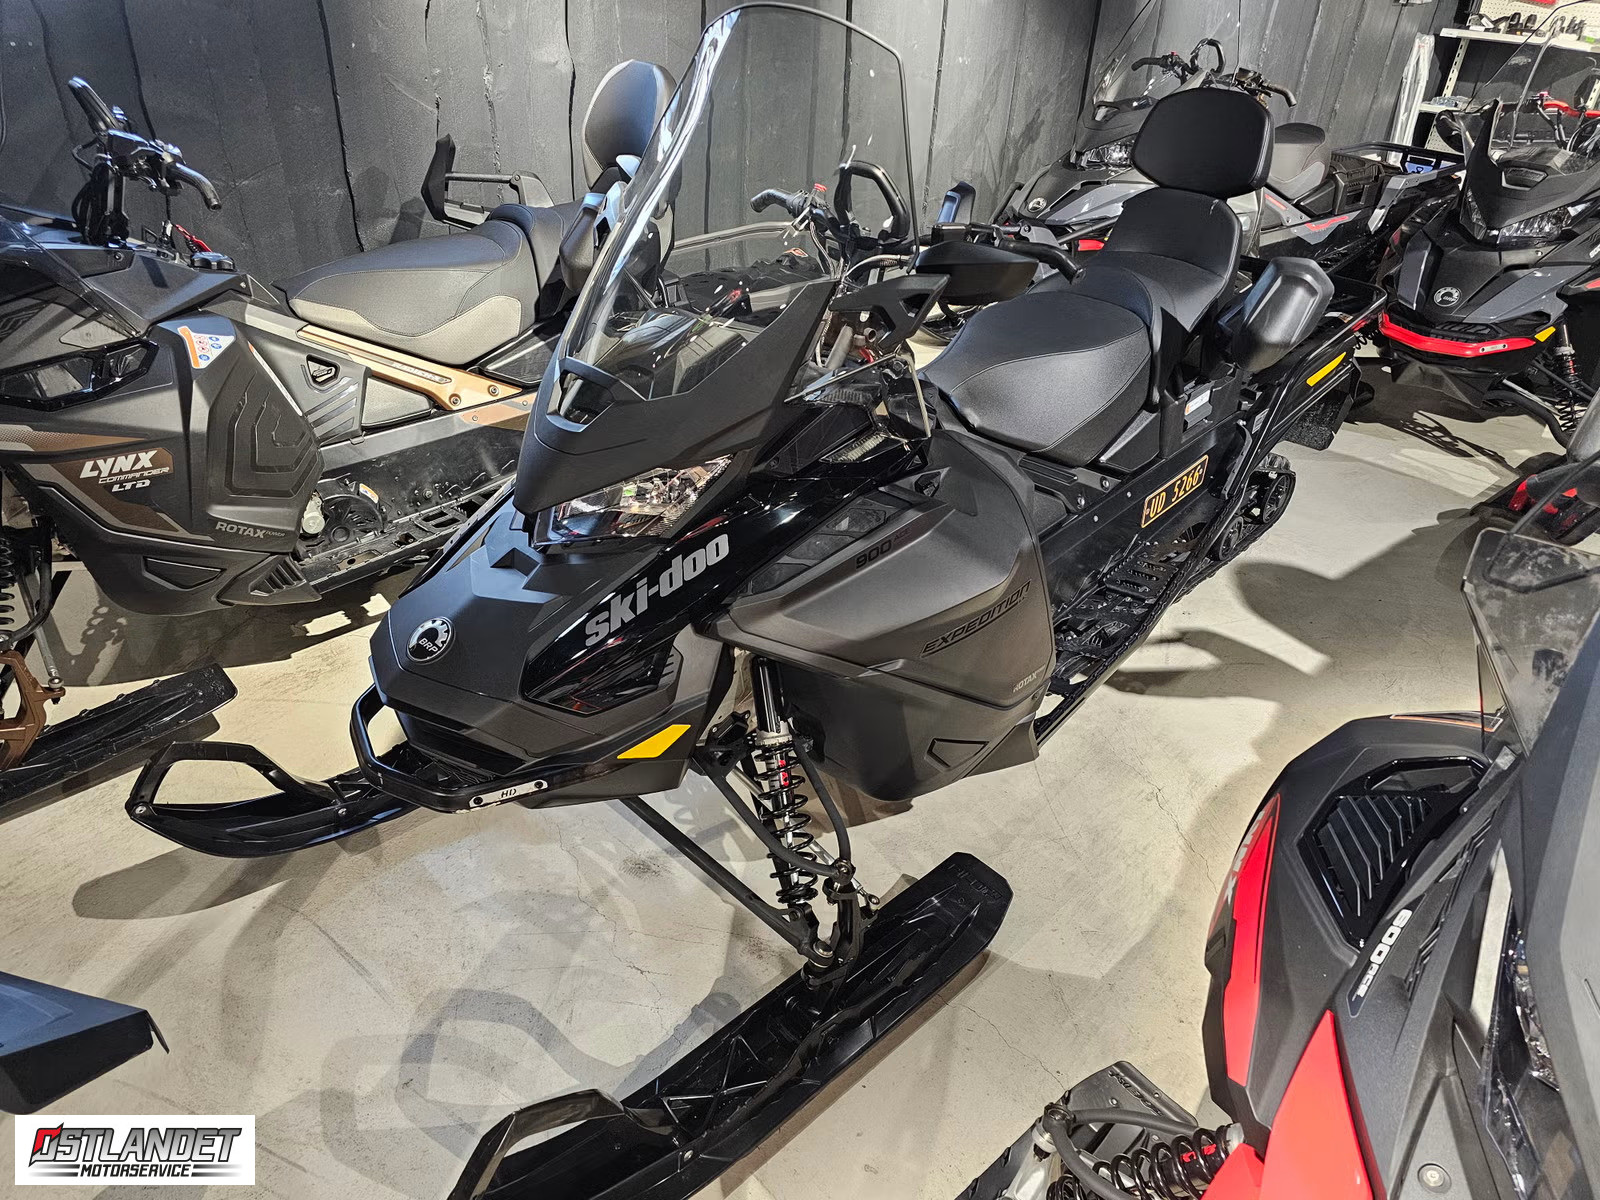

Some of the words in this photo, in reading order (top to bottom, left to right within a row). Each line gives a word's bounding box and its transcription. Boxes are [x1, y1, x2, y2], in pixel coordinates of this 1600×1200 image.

[80, 450, 158, 478] LYNX
[98, 466, 170, 484] COMMANDER
[111, 479, 151, 493] LTD
[1149, 491, 1166, 518] UD
[1171, 464, 1201, 503] 5266
[215, 521, 267, 539] ROTAX
[856, 539, 892, 569] 900
[922, 580, 1031, 654] EXPEDITION
[418, 637, 439, 652] BRP
[501, 788, 517, 798] HD
